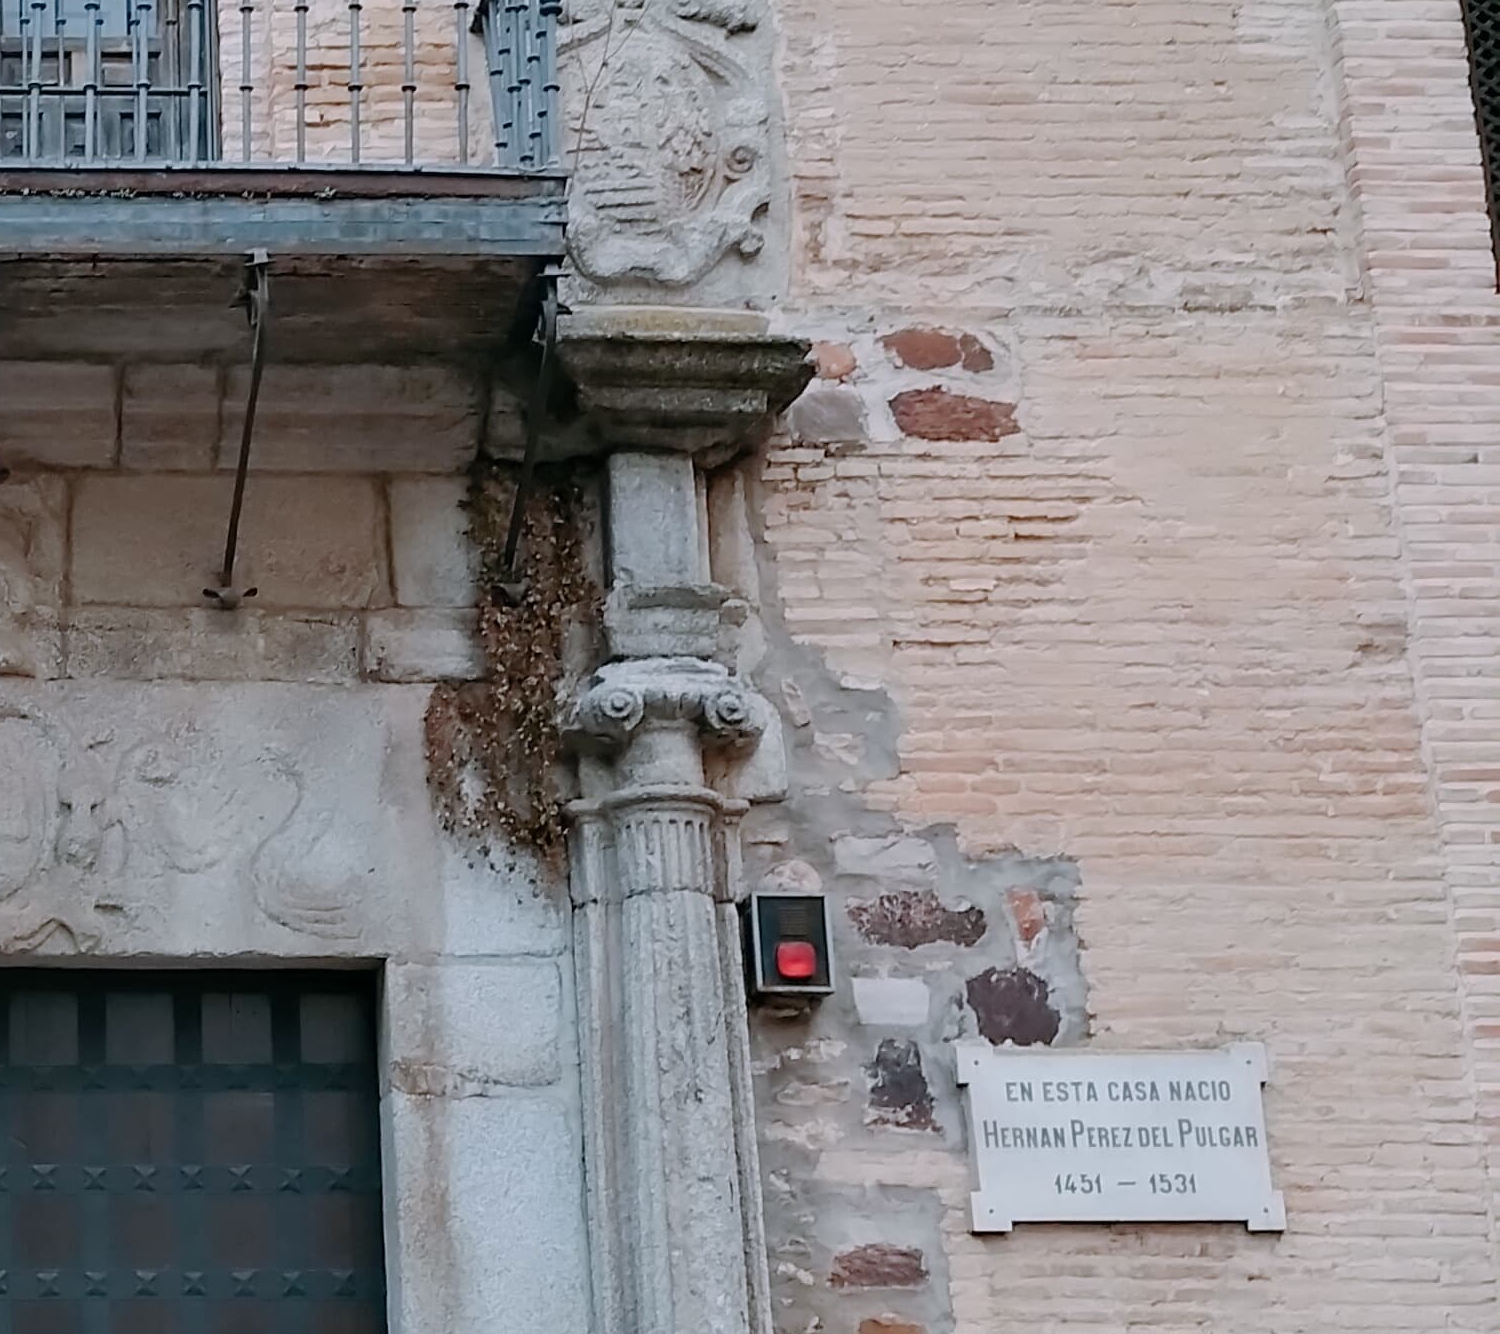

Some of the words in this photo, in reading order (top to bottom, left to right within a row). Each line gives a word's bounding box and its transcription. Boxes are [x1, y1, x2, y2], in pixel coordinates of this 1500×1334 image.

[1005, 1081, 1033, 1103] EN
[1042, 1081, 1099, 1102] ESTA
[1107, 1080, 1161, 1102] CASA
[1169, 1080, 1231, 1101] NACIO
[1138, 1127, 1174, 1148] DEL
[1054, 1174, 1102, 1195] 1451
[1149, 1173, 1198, 1194] 1531
